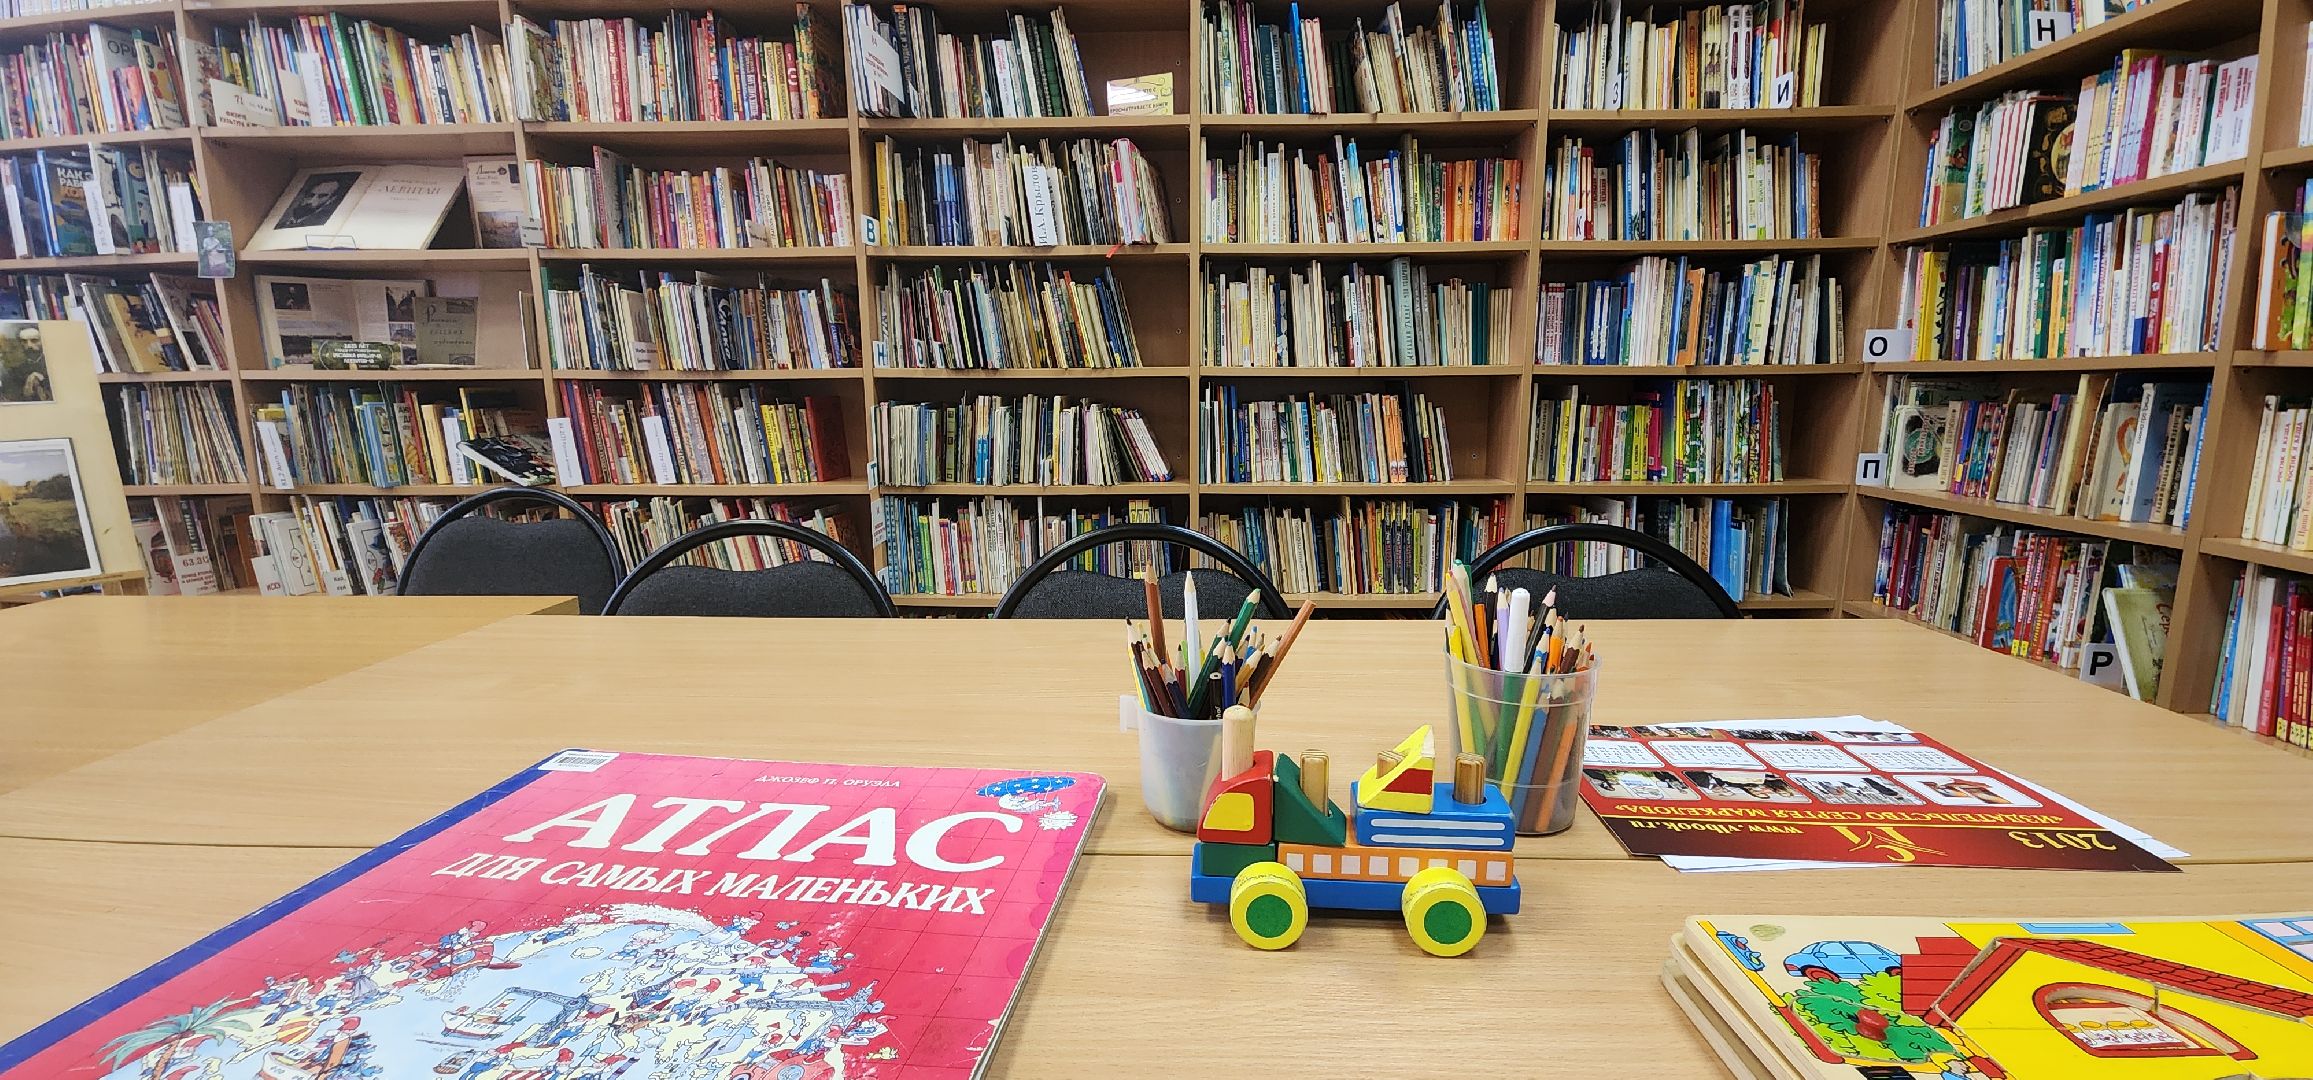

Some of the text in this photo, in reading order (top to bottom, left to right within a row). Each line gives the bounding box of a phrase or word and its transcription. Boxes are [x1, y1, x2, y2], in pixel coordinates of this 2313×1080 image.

[2037, 19, 2056, 42] Н
[1777, 80, 1789, 104] И
[1027, 164, 1046, 217] Крылов
[867, 219, 876, 243] В
[1869, 336, 1888, 357] О
[1863, 459, 1881, 479] П
[2089, 652, 2114, 676] Р
[755, 775, 820, 785] ДЖОЗЕФ
[1770, 807, 1861, 821] СЕРГЕЯ
[502, 793, 1024, 872] АТЛАС
[1627, 819, 1805, 836] www.vlbook.ru
[2007, 831, 2117, 852] 2013
[432, 852, 996, 916] ДЛЯ САМЫХ МАЛЕНЬКИХ
